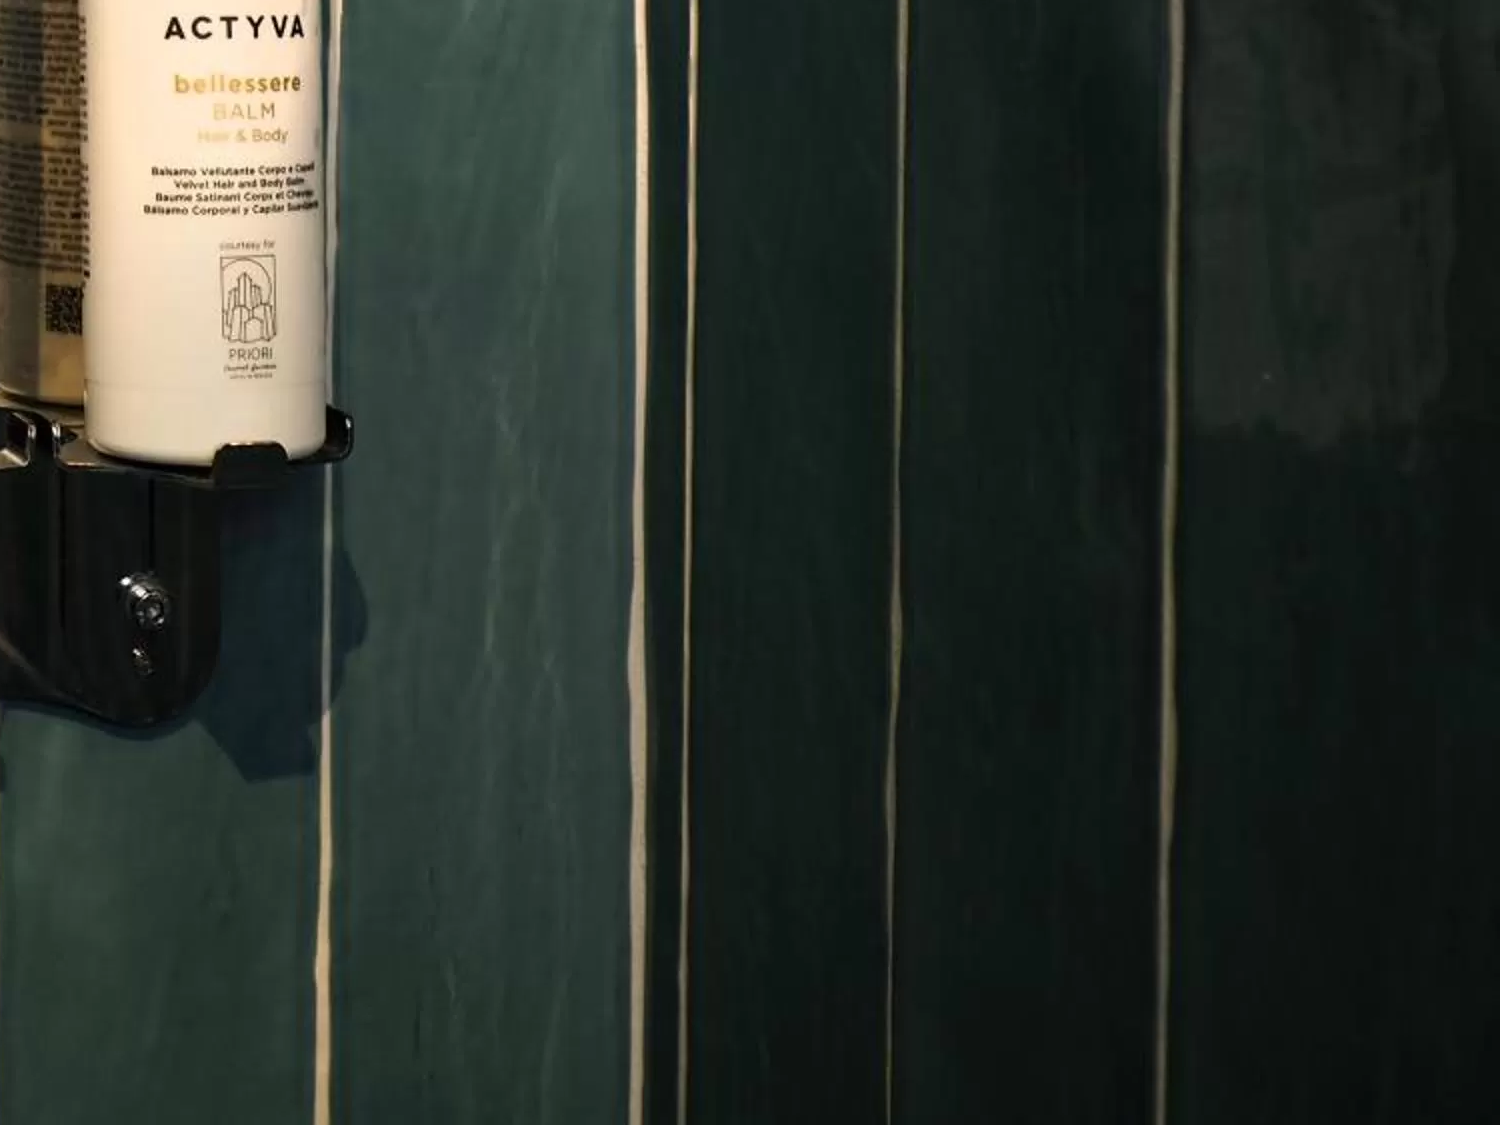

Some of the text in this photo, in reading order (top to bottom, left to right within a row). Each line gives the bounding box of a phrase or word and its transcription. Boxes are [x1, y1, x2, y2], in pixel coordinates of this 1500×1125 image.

[163, 14, 305, 40] ACTYVA
[174, 74, 301, 94] bellessere
[213, 102, 275, 120] BALM
[235, 130, 247, 142] &
[252, 127, 289, 144] Body
[173, 179, 209, 189] Velvet
[213, 179, 235, 189] Hair
[238, 178, 257, 188] and
[260, 178, 283, 189] Body
[155, 192, 193, 202] Baume
[192, 204, 240, 216] Corporal
[228, 346, 273, 360] PRIORI
